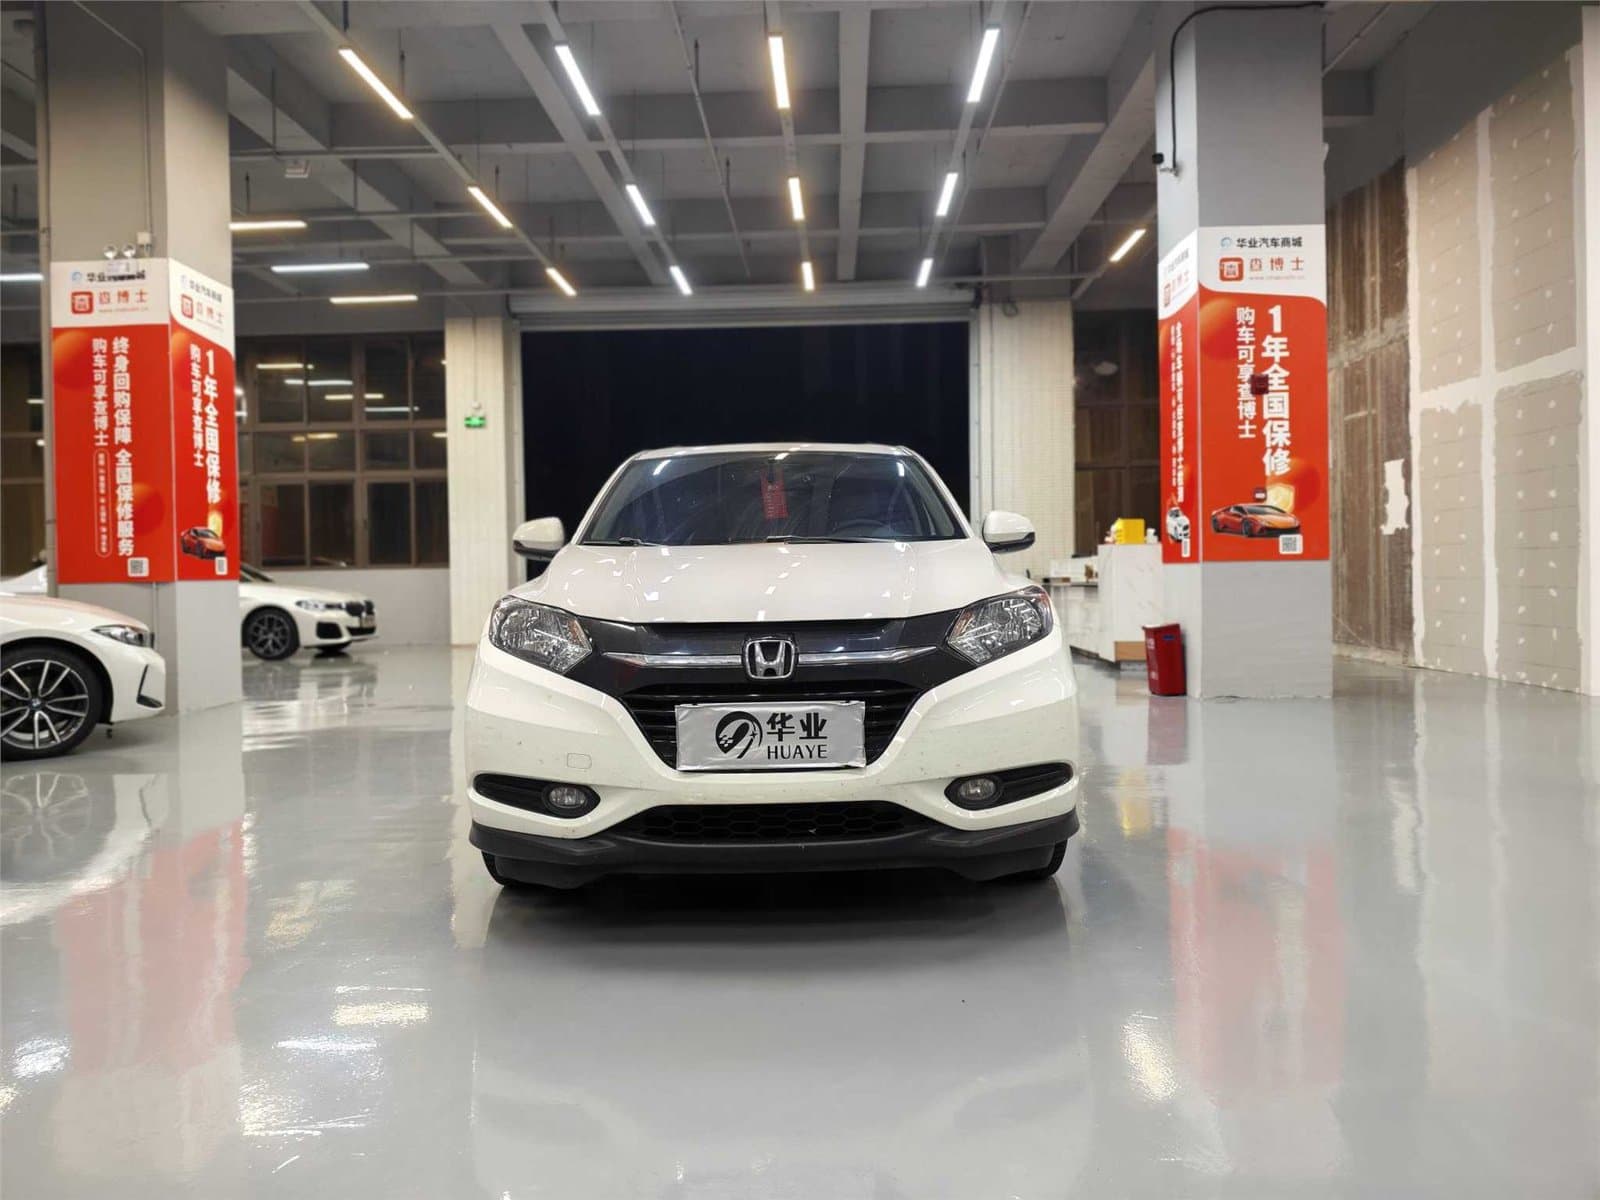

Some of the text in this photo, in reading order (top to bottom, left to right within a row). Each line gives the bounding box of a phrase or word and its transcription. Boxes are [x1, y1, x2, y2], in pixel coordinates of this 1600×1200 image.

[1236, 236, 1303, 249] 华业汽车商城
[92, 337, 109, 447] 购车可享查博士
[203, 349, 222, 505] 1年全国保修
[1236, 306, 1256, 438] 购车可享查博士
[1261, 304, 1291, 477] 1年全国保修
[766, 712, 828, 742] 华业
[767, 744, 828, 760] HUAYE
